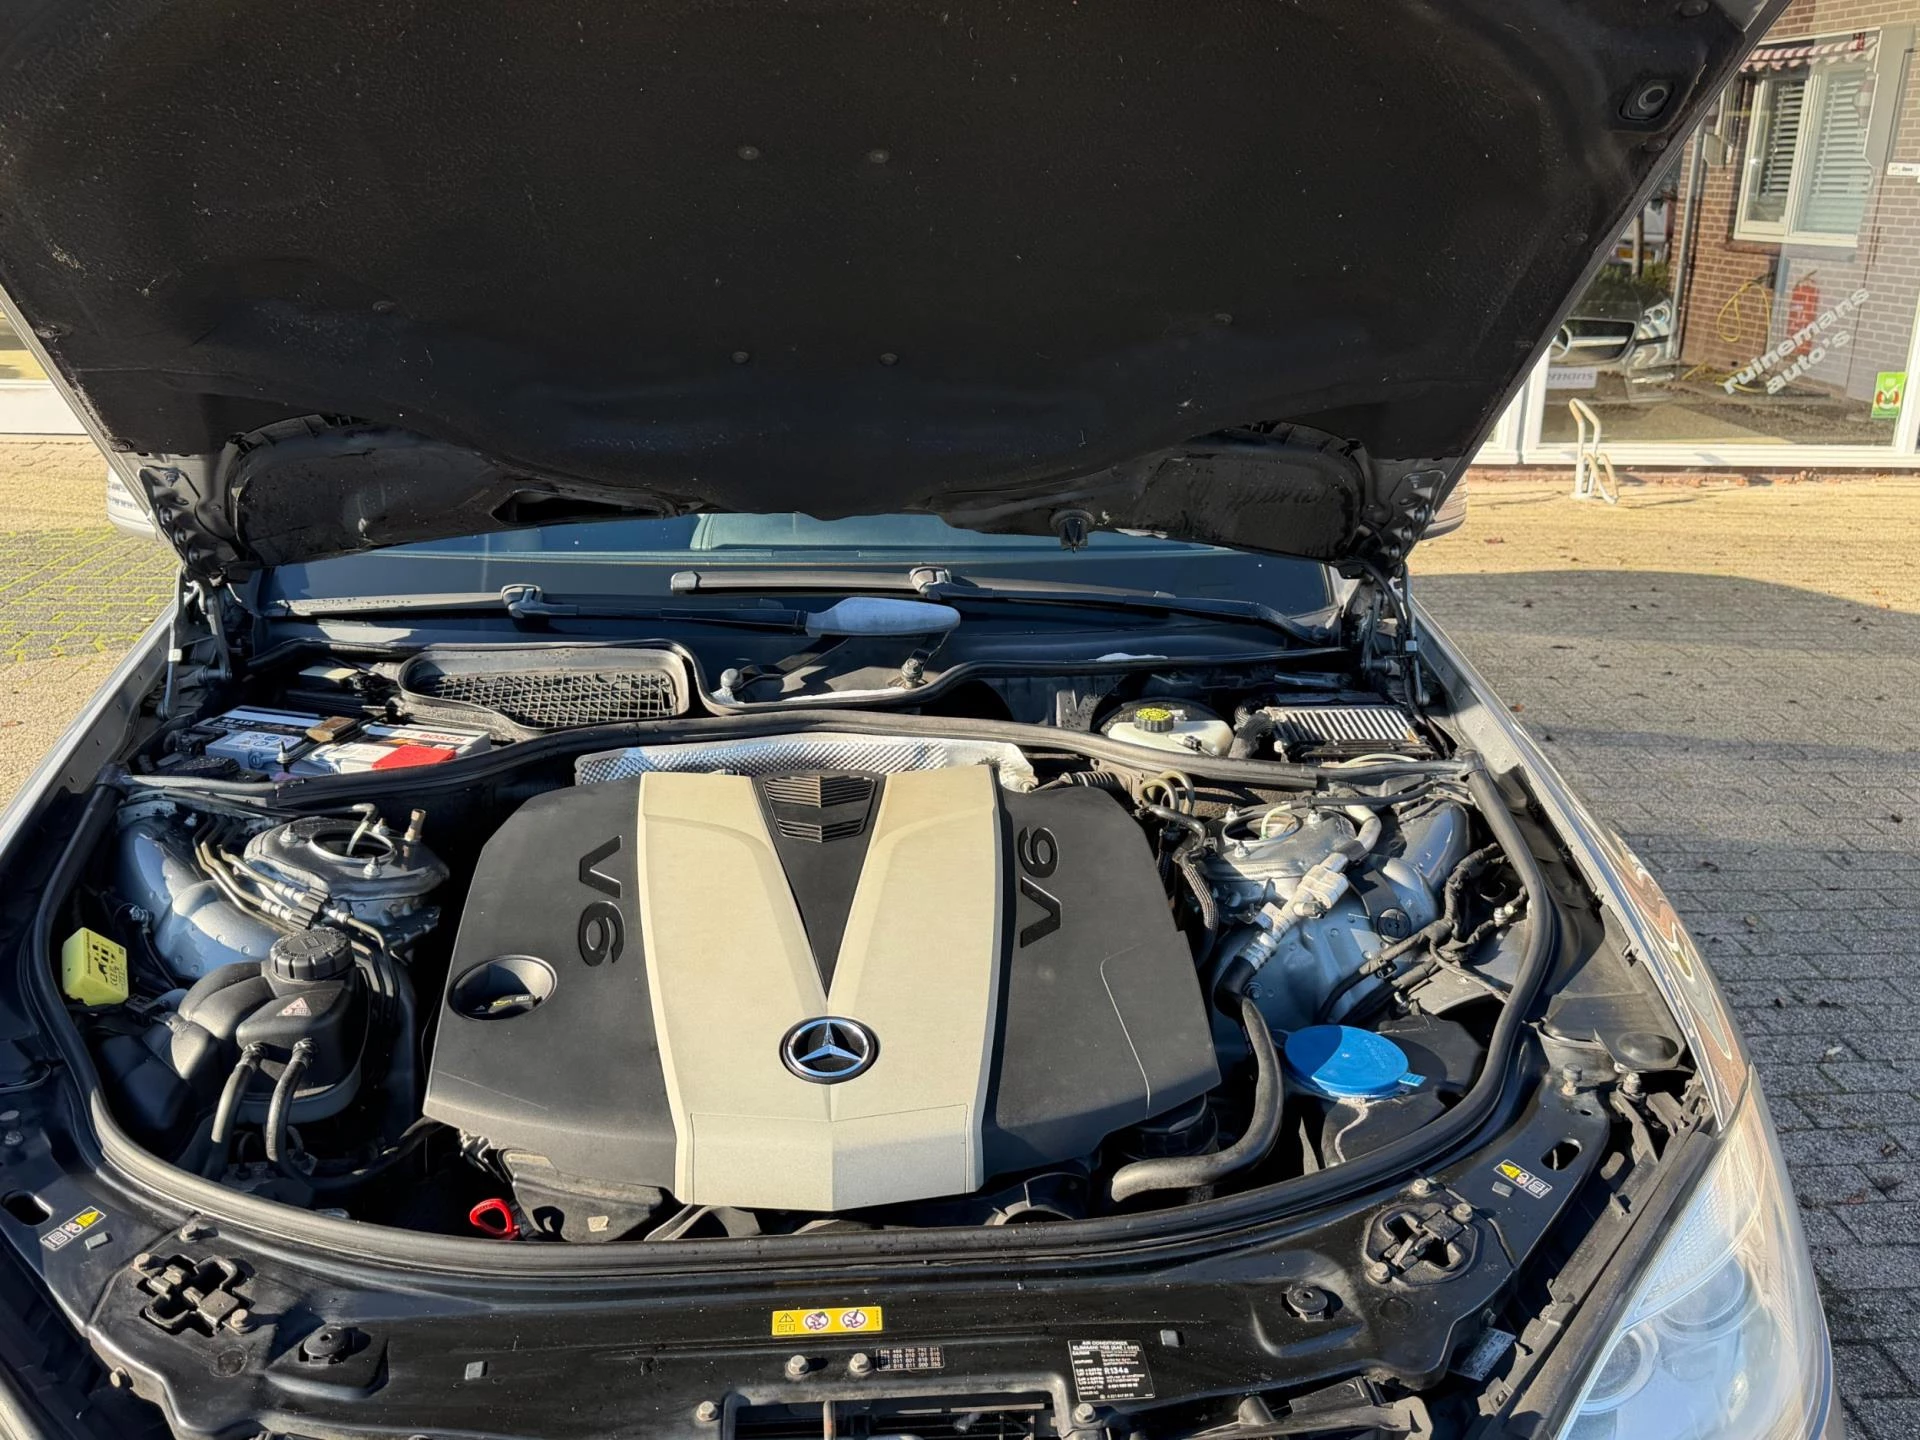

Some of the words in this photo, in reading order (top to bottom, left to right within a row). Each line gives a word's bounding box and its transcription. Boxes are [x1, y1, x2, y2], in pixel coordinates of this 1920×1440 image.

[1723, 288, 1870, 395] ruinemans
[1765, 330, 1850, 395] auto's
[419, 733, 467, 743] BOSCH
[578, 835, 626, 967] V6
[1017, 826, 1063, 948] V6
